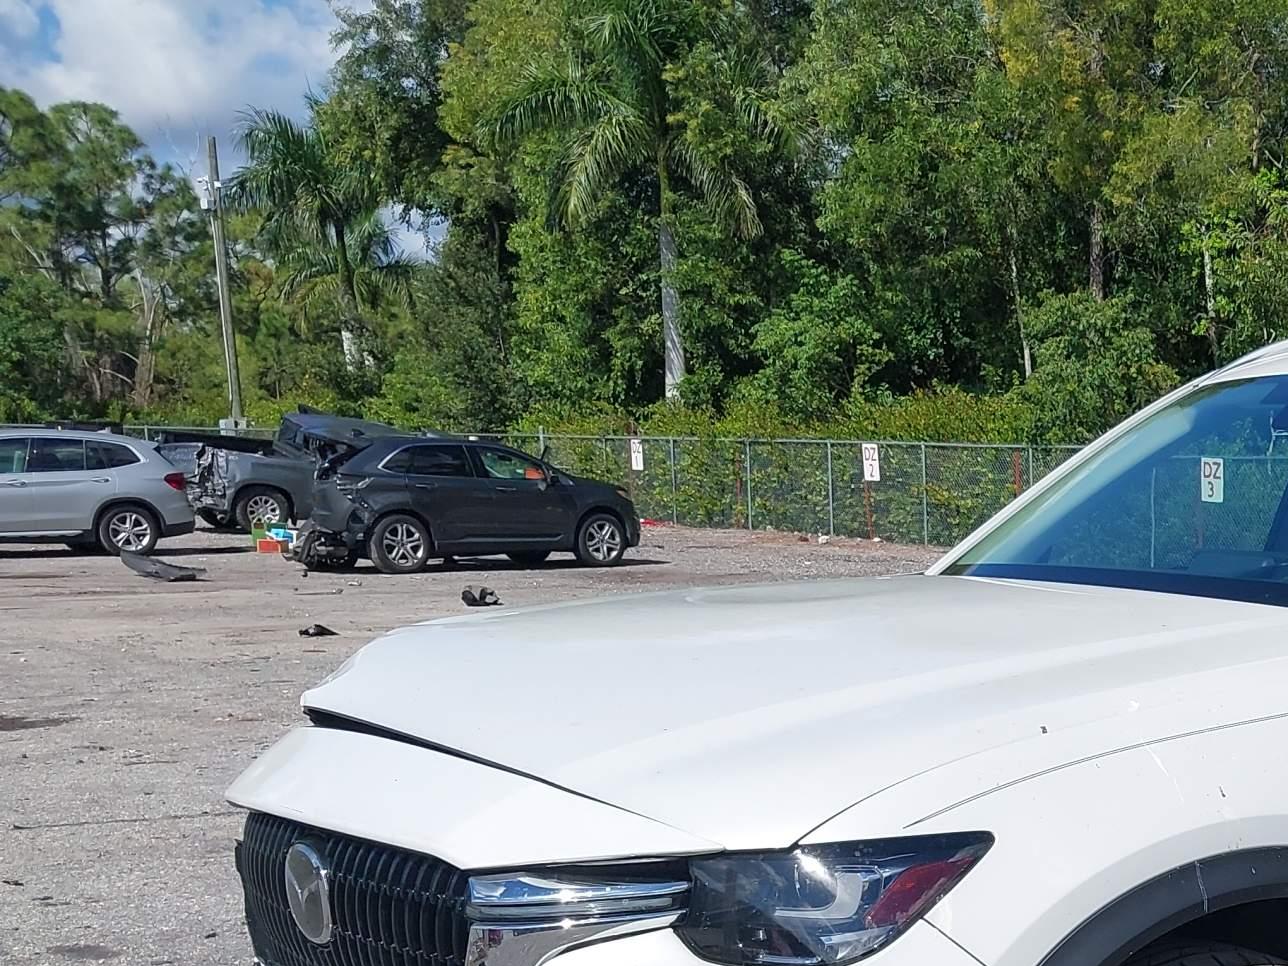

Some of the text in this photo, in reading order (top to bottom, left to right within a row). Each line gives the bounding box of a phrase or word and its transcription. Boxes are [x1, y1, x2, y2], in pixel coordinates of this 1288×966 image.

[632, 441, 642, 454] DZ
[864, 446, 877, 461] DZ
[869, 463, 875, 478] 2
[1203, 461, 1222, 480] DZ
[1207, 481, 1215, 498] 3
